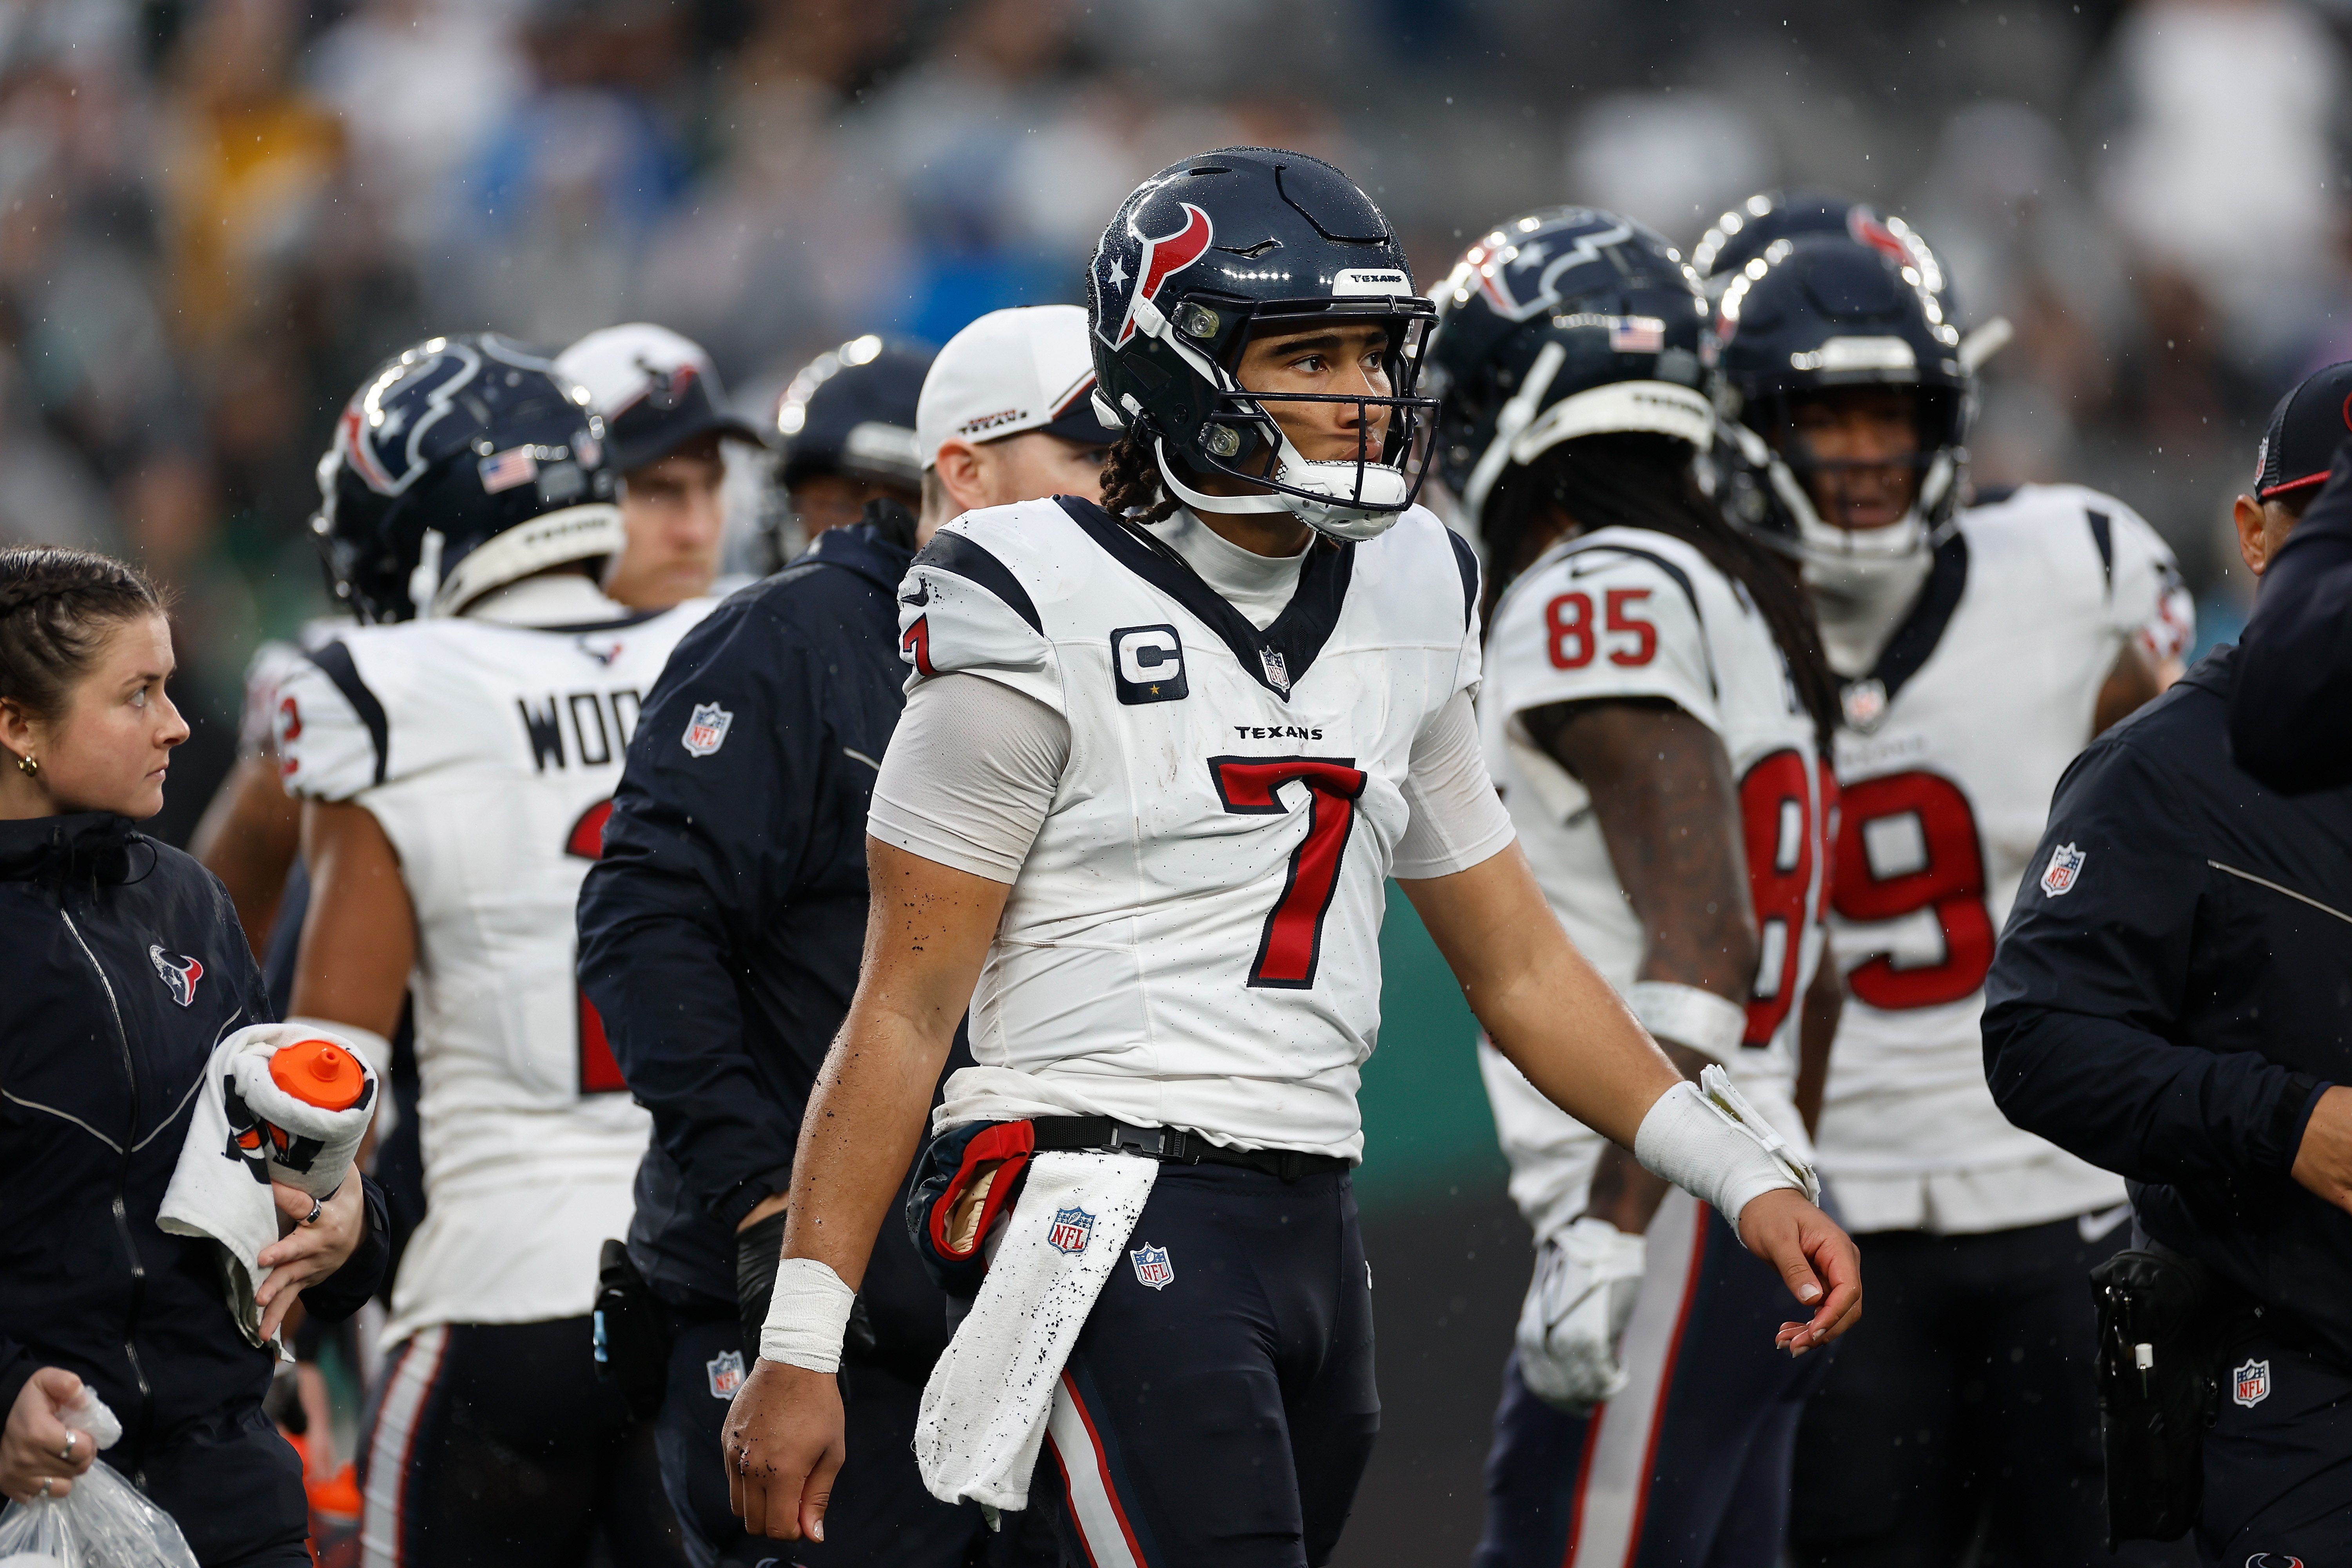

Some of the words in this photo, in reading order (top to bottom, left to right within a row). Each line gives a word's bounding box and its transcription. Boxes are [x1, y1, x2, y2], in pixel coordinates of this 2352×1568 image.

[1544, 588, 1659, 670] 85
[903, 612, 938, 677] 7
[1118, 630, 1180, 684] C
[1268, 666, 1288, 684] NFL
[690, 725, 715, 746] NFL
[1234, 726, 1323, 740] TEXANS
[1206, 755, 1367, 989] 7
[2047, 867, 2070, 887] NFL
[1051, 1224, 1085, 1250] NFL
[1140, 1264, 1169, 1281] NFL
[715, 1371, 740, 1391] NFL
[2239, 1379, 2263, 1398] NFL
